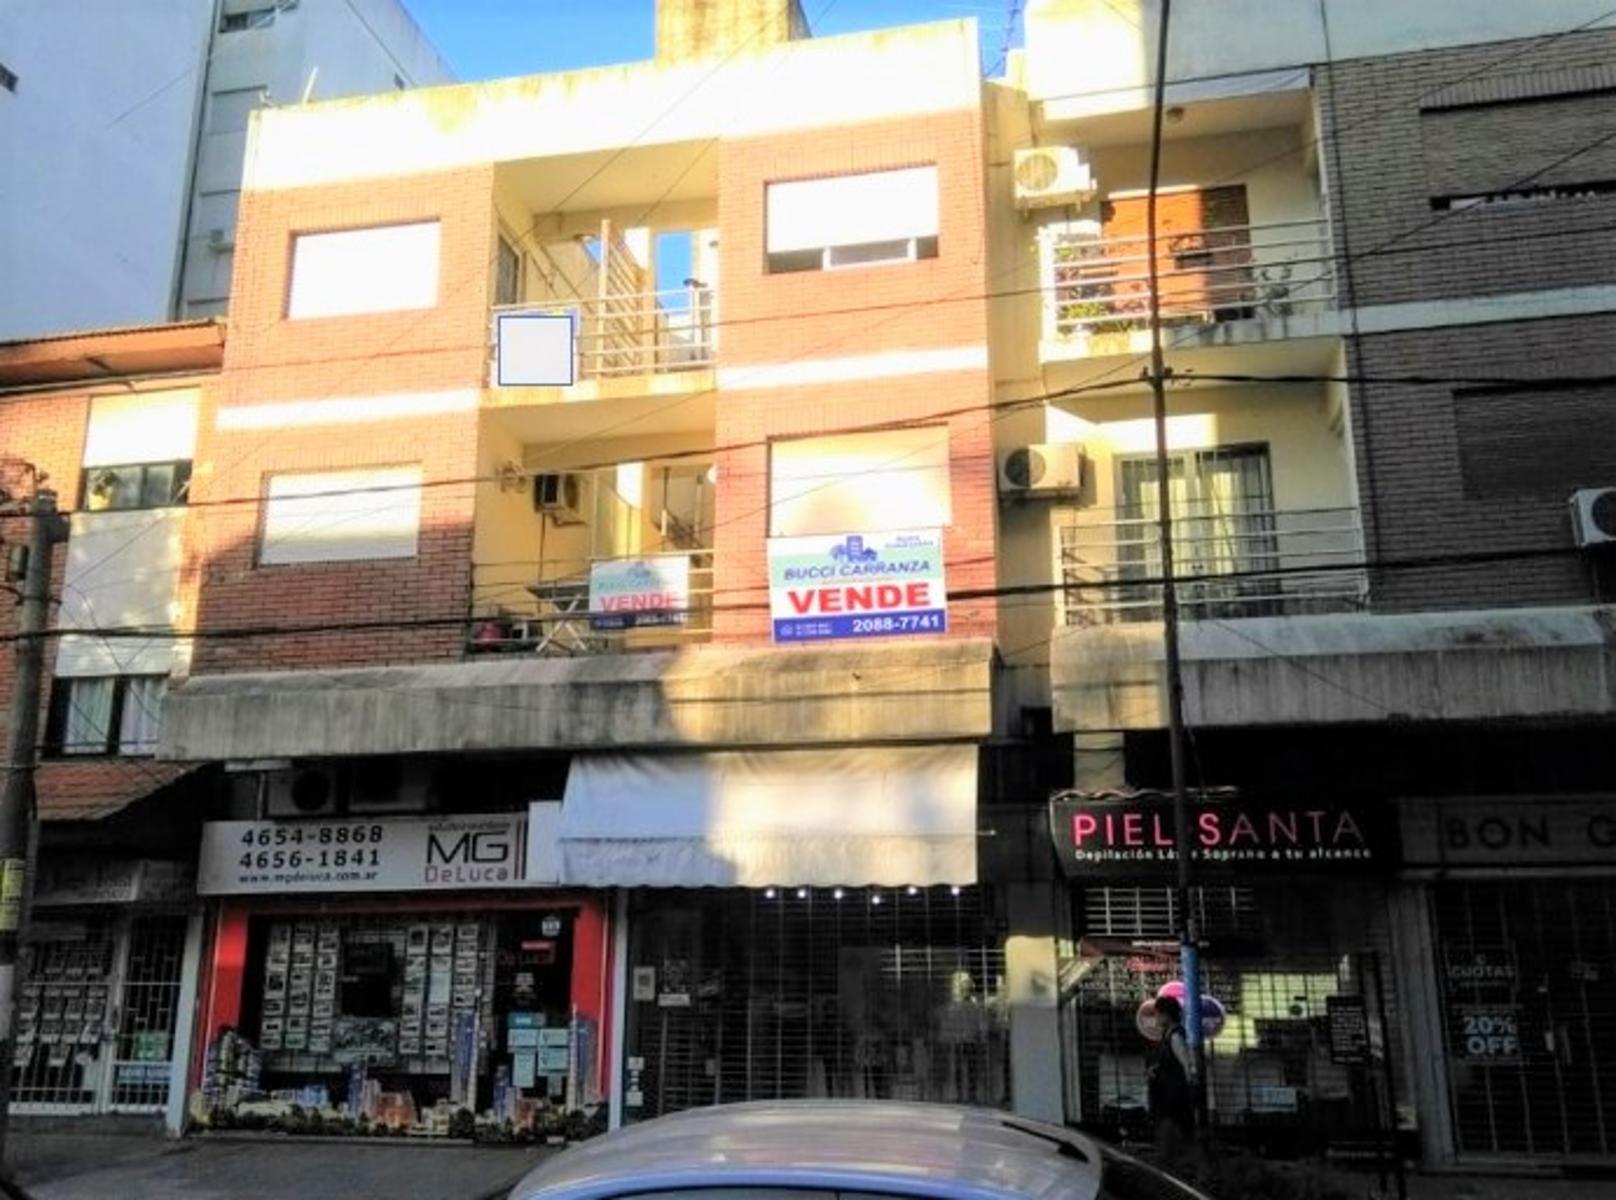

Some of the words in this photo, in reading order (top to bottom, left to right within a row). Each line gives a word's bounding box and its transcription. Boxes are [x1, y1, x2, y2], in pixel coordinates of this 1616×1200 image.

[784, 564, 836, 580] BUCCI
[839, 560, 931, 577] CARRANZA
[599, 593, 678, 612] VENDE
[787, 582, 931, 614] VENDE
[852, 615, 939, 633] 2088-7741
[241, 825, 383, 846] 4654-8868
[1071, 812, 1176, 847] PIEL
[1197, 809, 1367, 846] SANTA
[1445, 815, 1550, 848] BON
[427, 831, 508, 864] MG
[1075, 848, 1153, 862] Depilación
[1202, 848, 1266, 862] Soprano
[239, 849, 381, 869] 4656-1841
[1463, 1016, 1518, 1035] 20%
[1466, 1035, 1520, 1055] OFF
